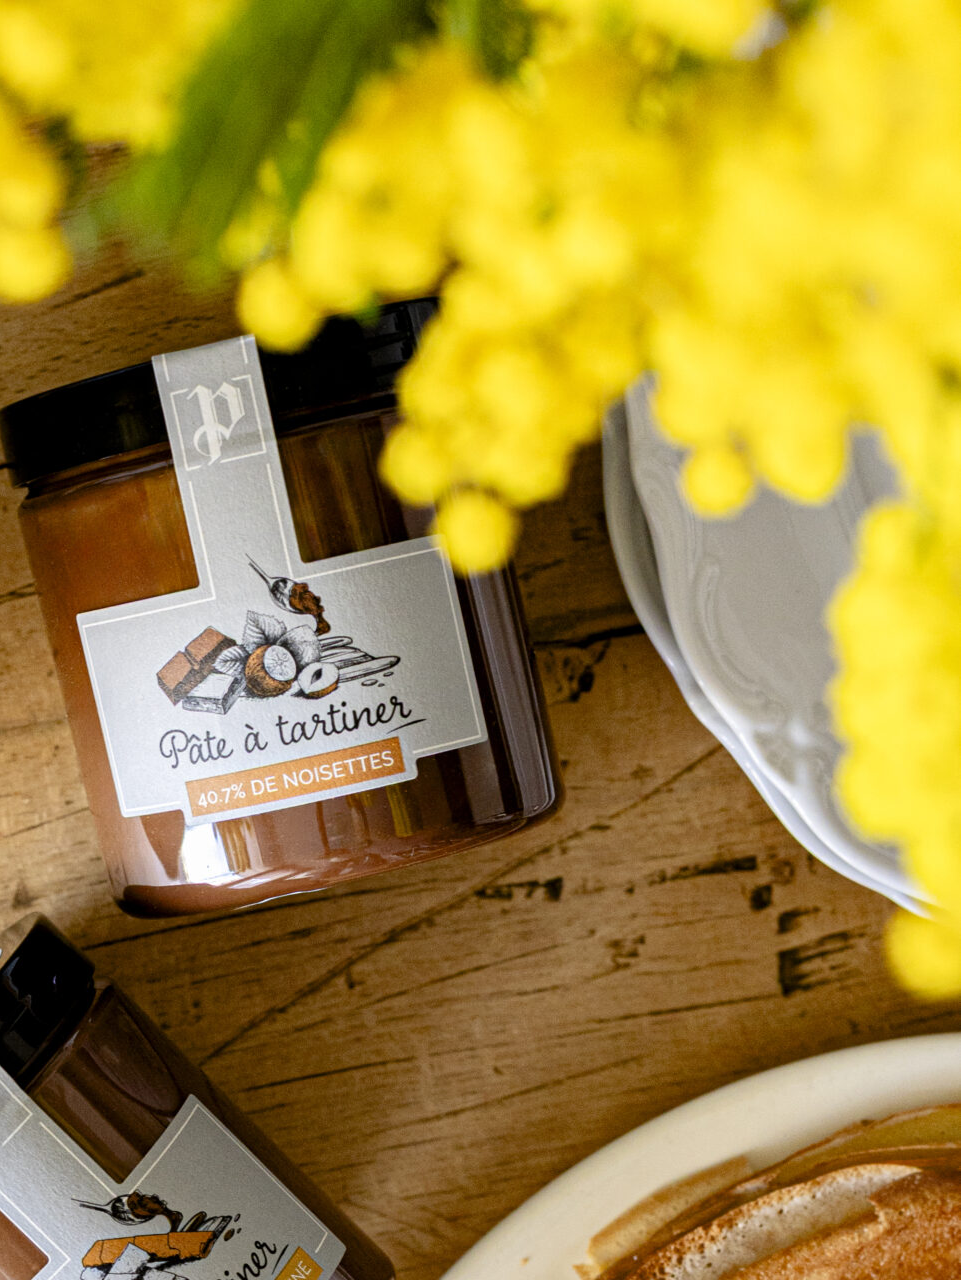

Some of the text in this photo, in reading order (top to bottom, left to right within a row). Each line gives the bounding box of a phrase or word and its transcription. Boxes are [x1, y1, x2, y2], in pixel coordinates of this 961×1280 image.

[159, 695, 412, 769] Pâte à tartiner
[197, 750, 395, 808] 40.7% DE NOISETTES
